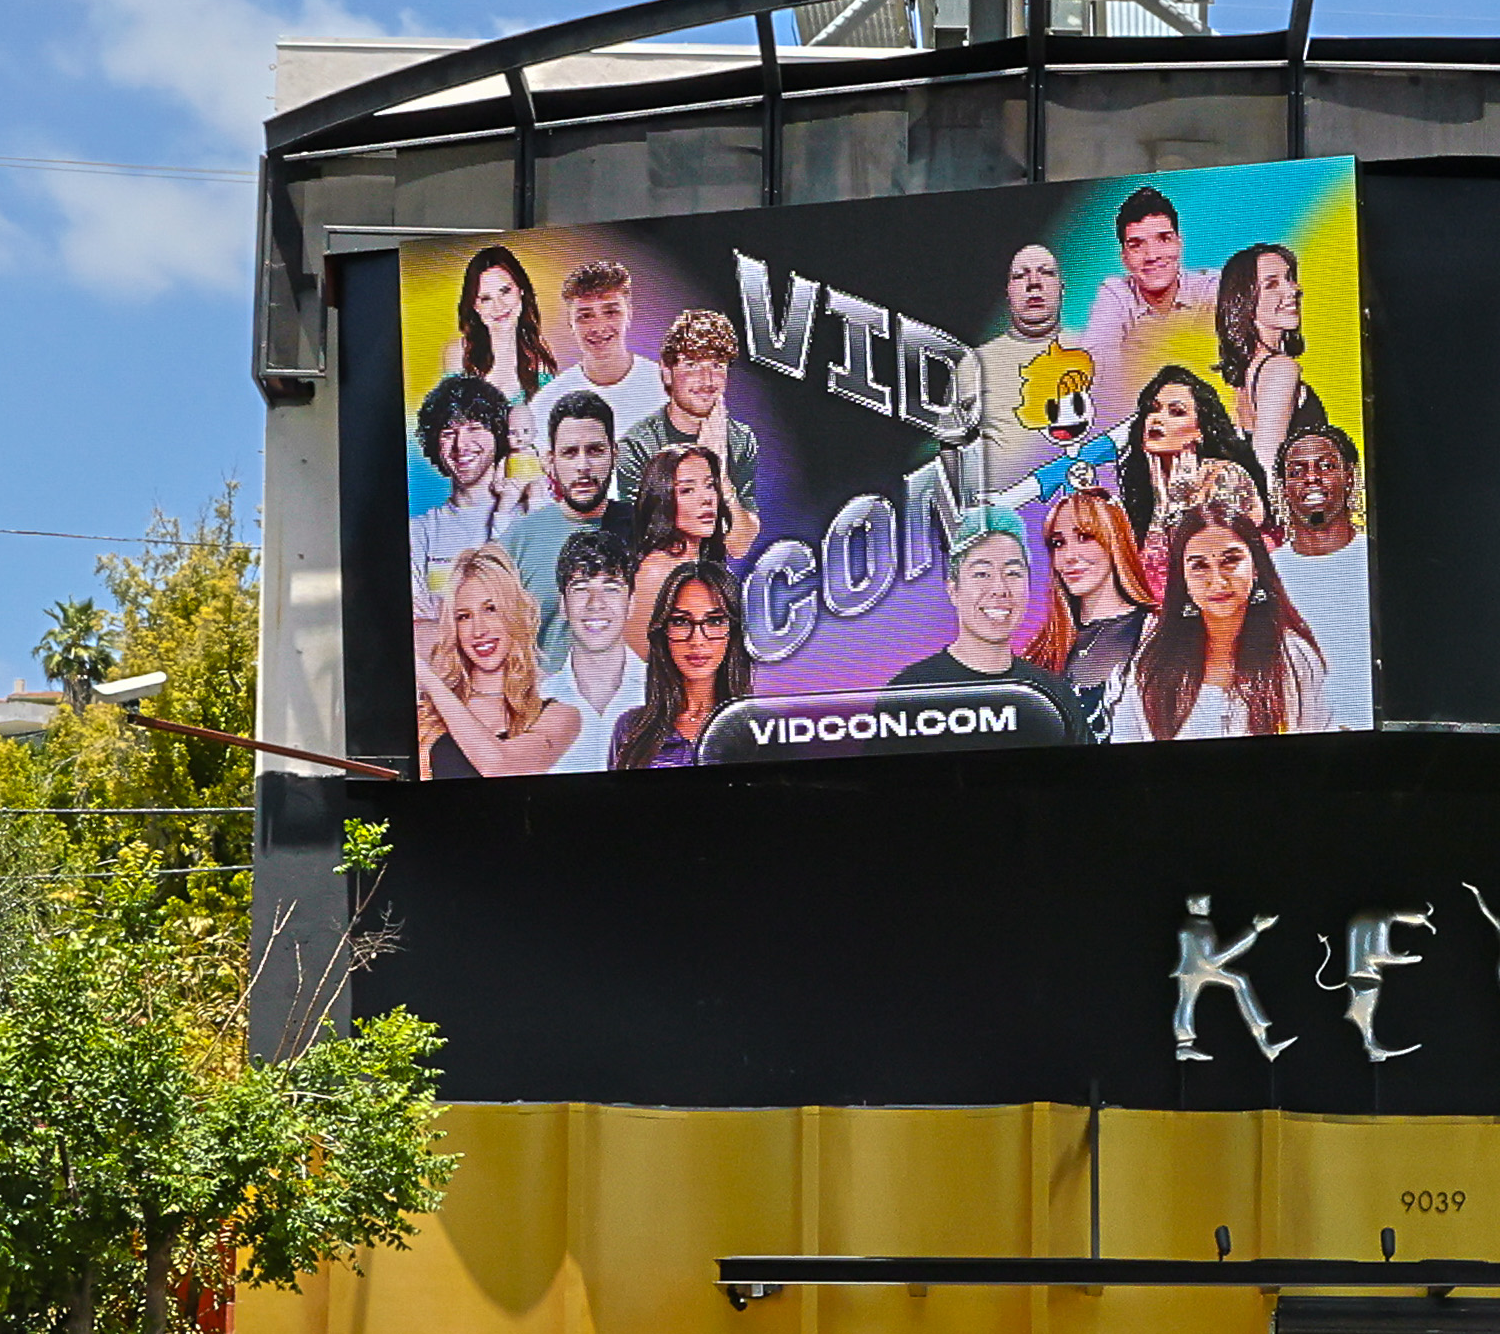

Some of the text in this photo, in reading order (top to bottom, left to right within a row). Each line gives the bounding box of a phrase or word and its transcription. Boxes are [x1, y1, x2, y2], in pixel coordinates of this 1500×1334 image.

[733, 248, 981, 442] VID
[741, 437, 988, 662] CON
[748, 704, 1018, 745] VIDCON.COM
[1401, 1190, 1467, 1213] 9039
